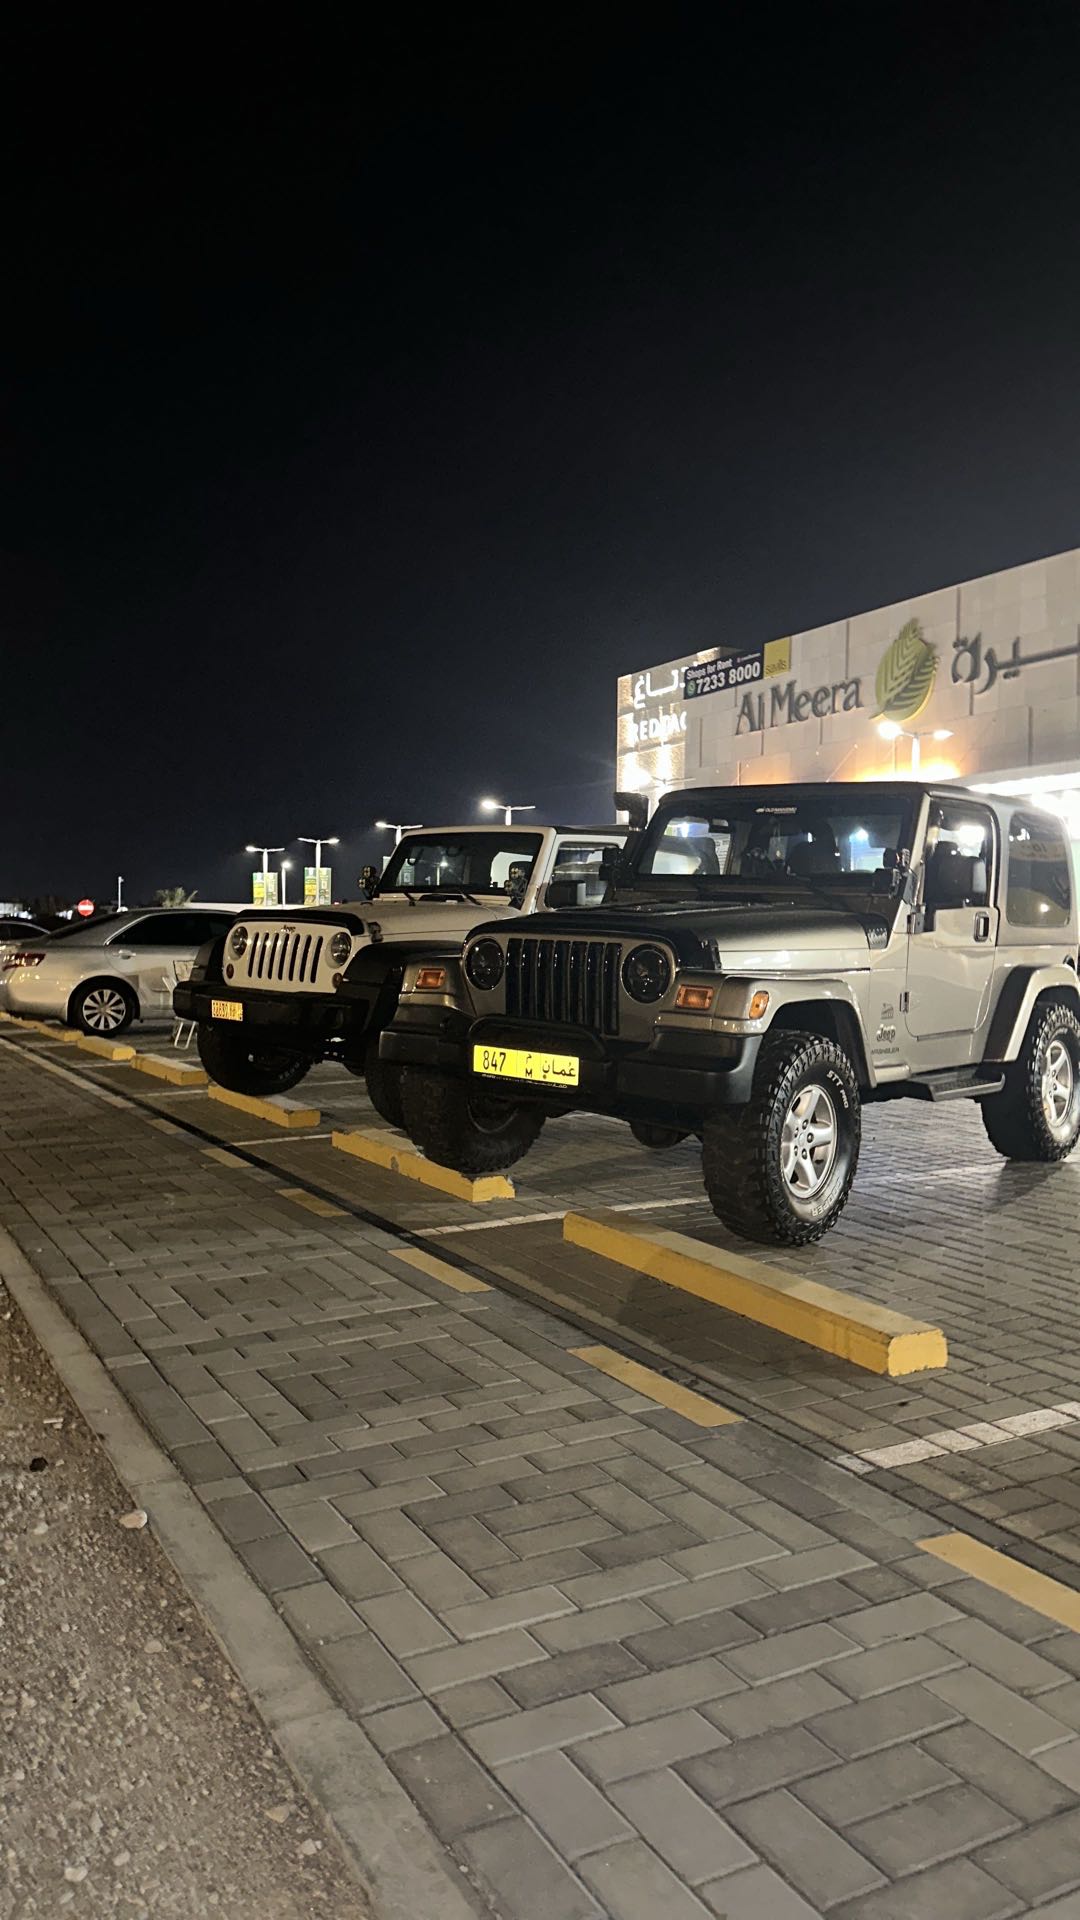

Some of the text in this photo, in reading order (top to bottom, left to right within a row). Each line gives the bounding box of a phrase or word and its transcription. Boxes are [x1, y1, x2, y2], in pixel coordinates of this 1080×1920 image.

[707, 664, 716, 674] for
[717, 658, 733, 670] Rent
[696, 661, 761, 694] 7233 8000
[735, 678, 864, 736] Al Meera
[876, 1024, 897, 1044] Jeep
[483, 1050, 507, 1072] 847
[525, 1068, 533, 1078] M
